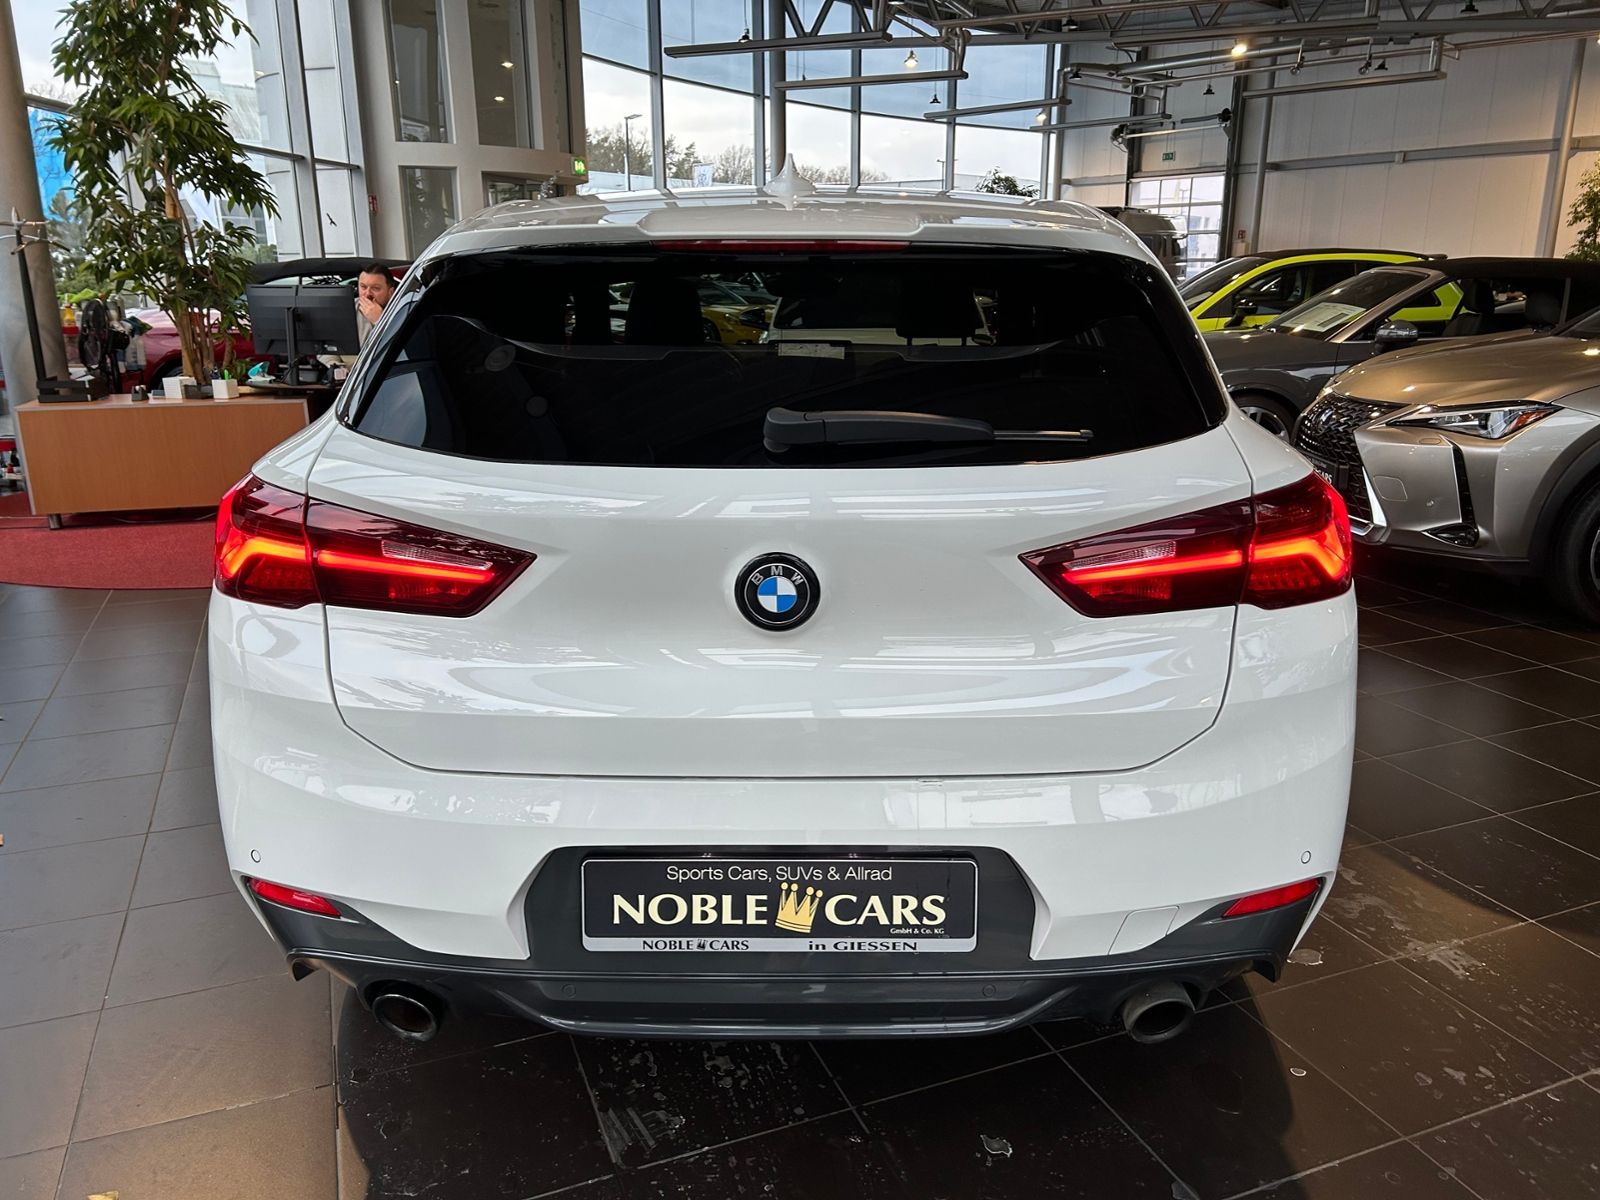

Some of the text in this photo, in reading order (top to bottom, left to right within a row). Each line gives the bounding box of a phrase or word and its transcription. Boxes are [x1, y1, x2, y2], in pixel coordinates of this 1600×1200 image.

[751, 565, 804, 586] BMW
[666, 866, 892, 883] Sports Cars, SUVs & Allrad
[613, 894, 946, 925] NOBLE CARS
[642, 940, 749, 950] NOBLE CARS
[809, 940, 917, 951] in GIESSEN
